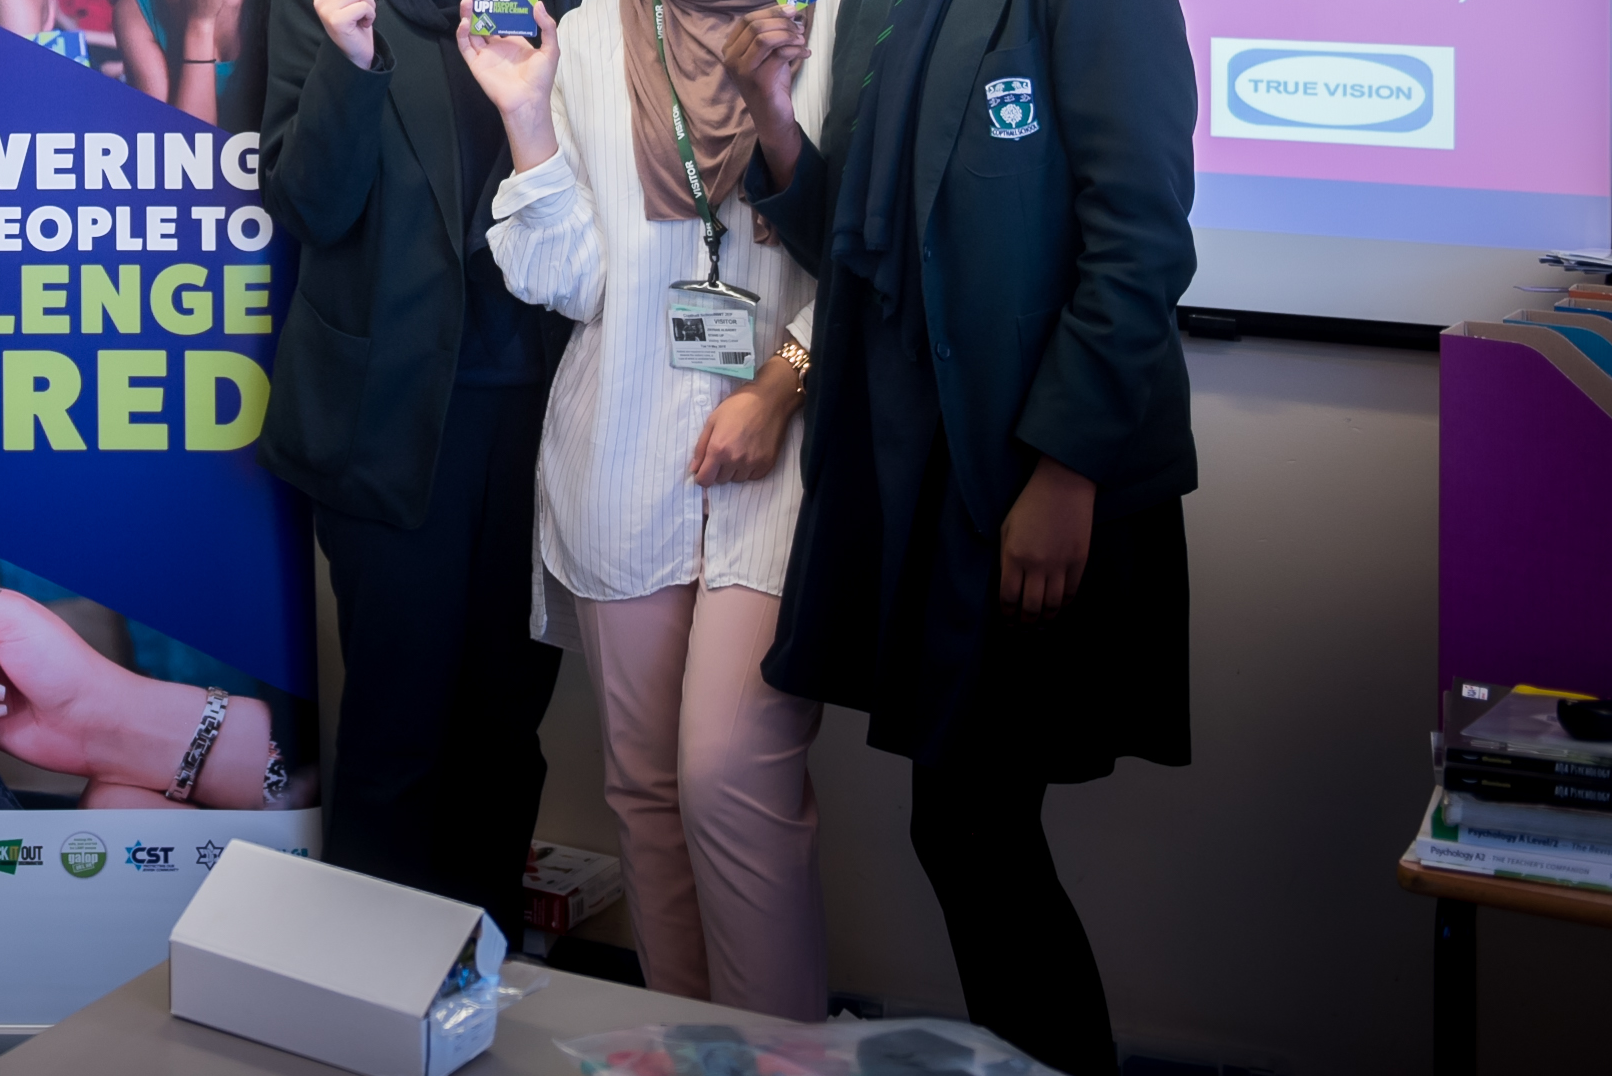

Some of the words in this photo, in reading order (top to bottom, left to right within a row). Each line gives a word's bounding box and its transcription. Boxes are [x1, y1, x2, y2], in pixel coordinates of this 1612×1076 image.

[474, 0, 493, 13] UP!
[654, 4, 664, 40] VISITOR
[1247, 78, 1319, 98] TRUE
[1322, 81, 1414, 102] VISION
[672, 103, 686, 141] VISITOR
[992, 127, 1018, 137] COPTHALL
[1017, 123, 1038, 135] SCHOOL
[684, 159, 703, 199] VISITOR
[191, 204, 274, 252] TO
[8, 845, 19, 861] IT
[20, 845, 44, 861] OUT
[67, 851, 99, 865] galop
[132, 846, 176, 864] CST
[1430, 845, 1474, 862] Psychology
[1475, 853, 1486, 862] A2
[1492, 854, 1506, 864] THE
[1506, 856, 1545, 869] TEACHER'S
[1545, 861, 1590, 875] COMPANION
